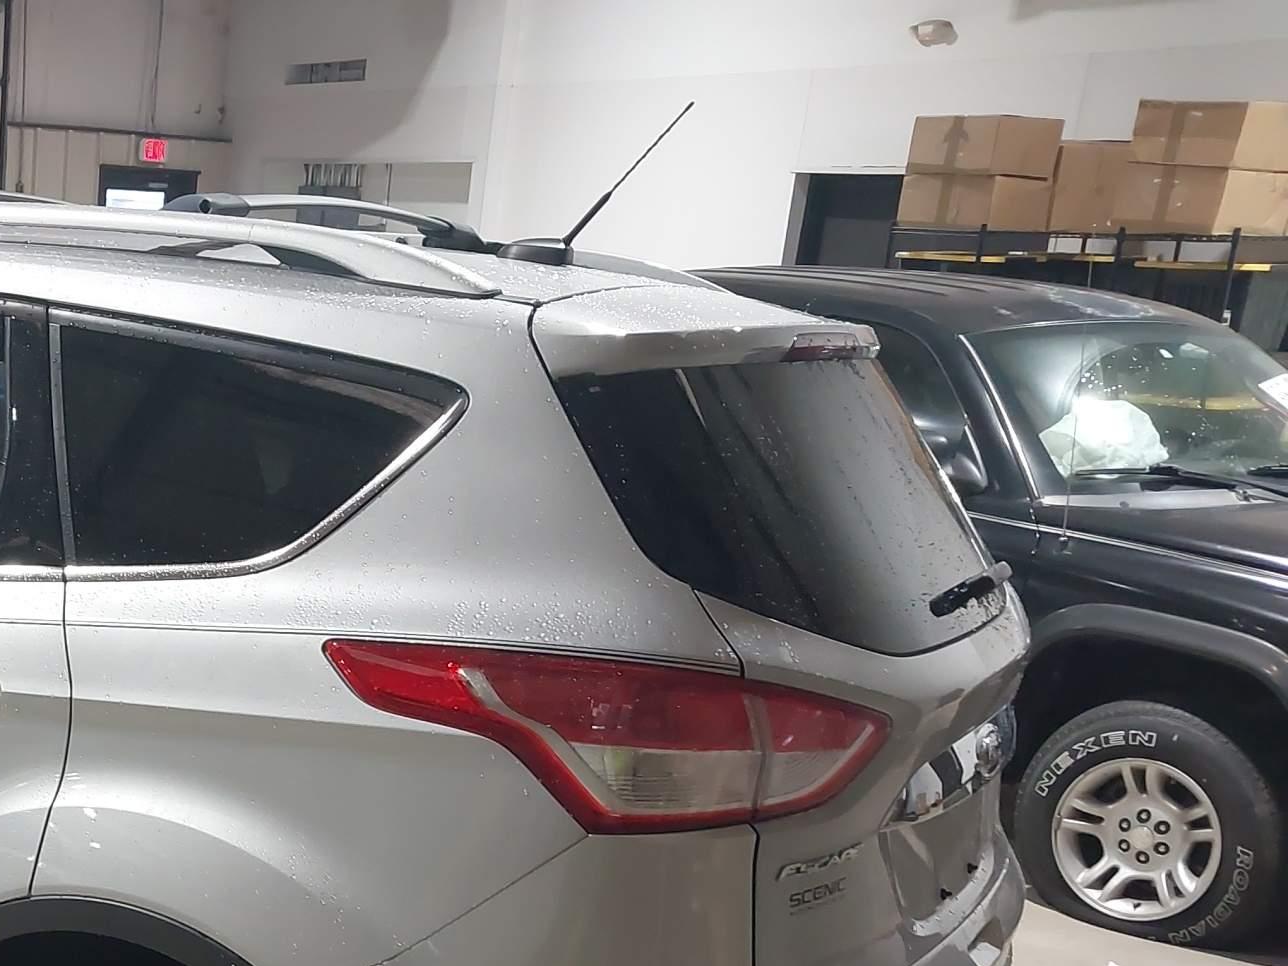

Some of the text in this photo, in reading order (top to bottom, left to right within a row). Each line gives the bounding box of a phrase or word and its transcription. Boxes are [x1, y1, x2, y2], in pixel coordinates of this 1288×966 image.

[1035, 730, 1157, 797] NEXEN
[789, 877, 847, 908] SCENIC
[1168, 845, 1255, 944] ROADIAN
